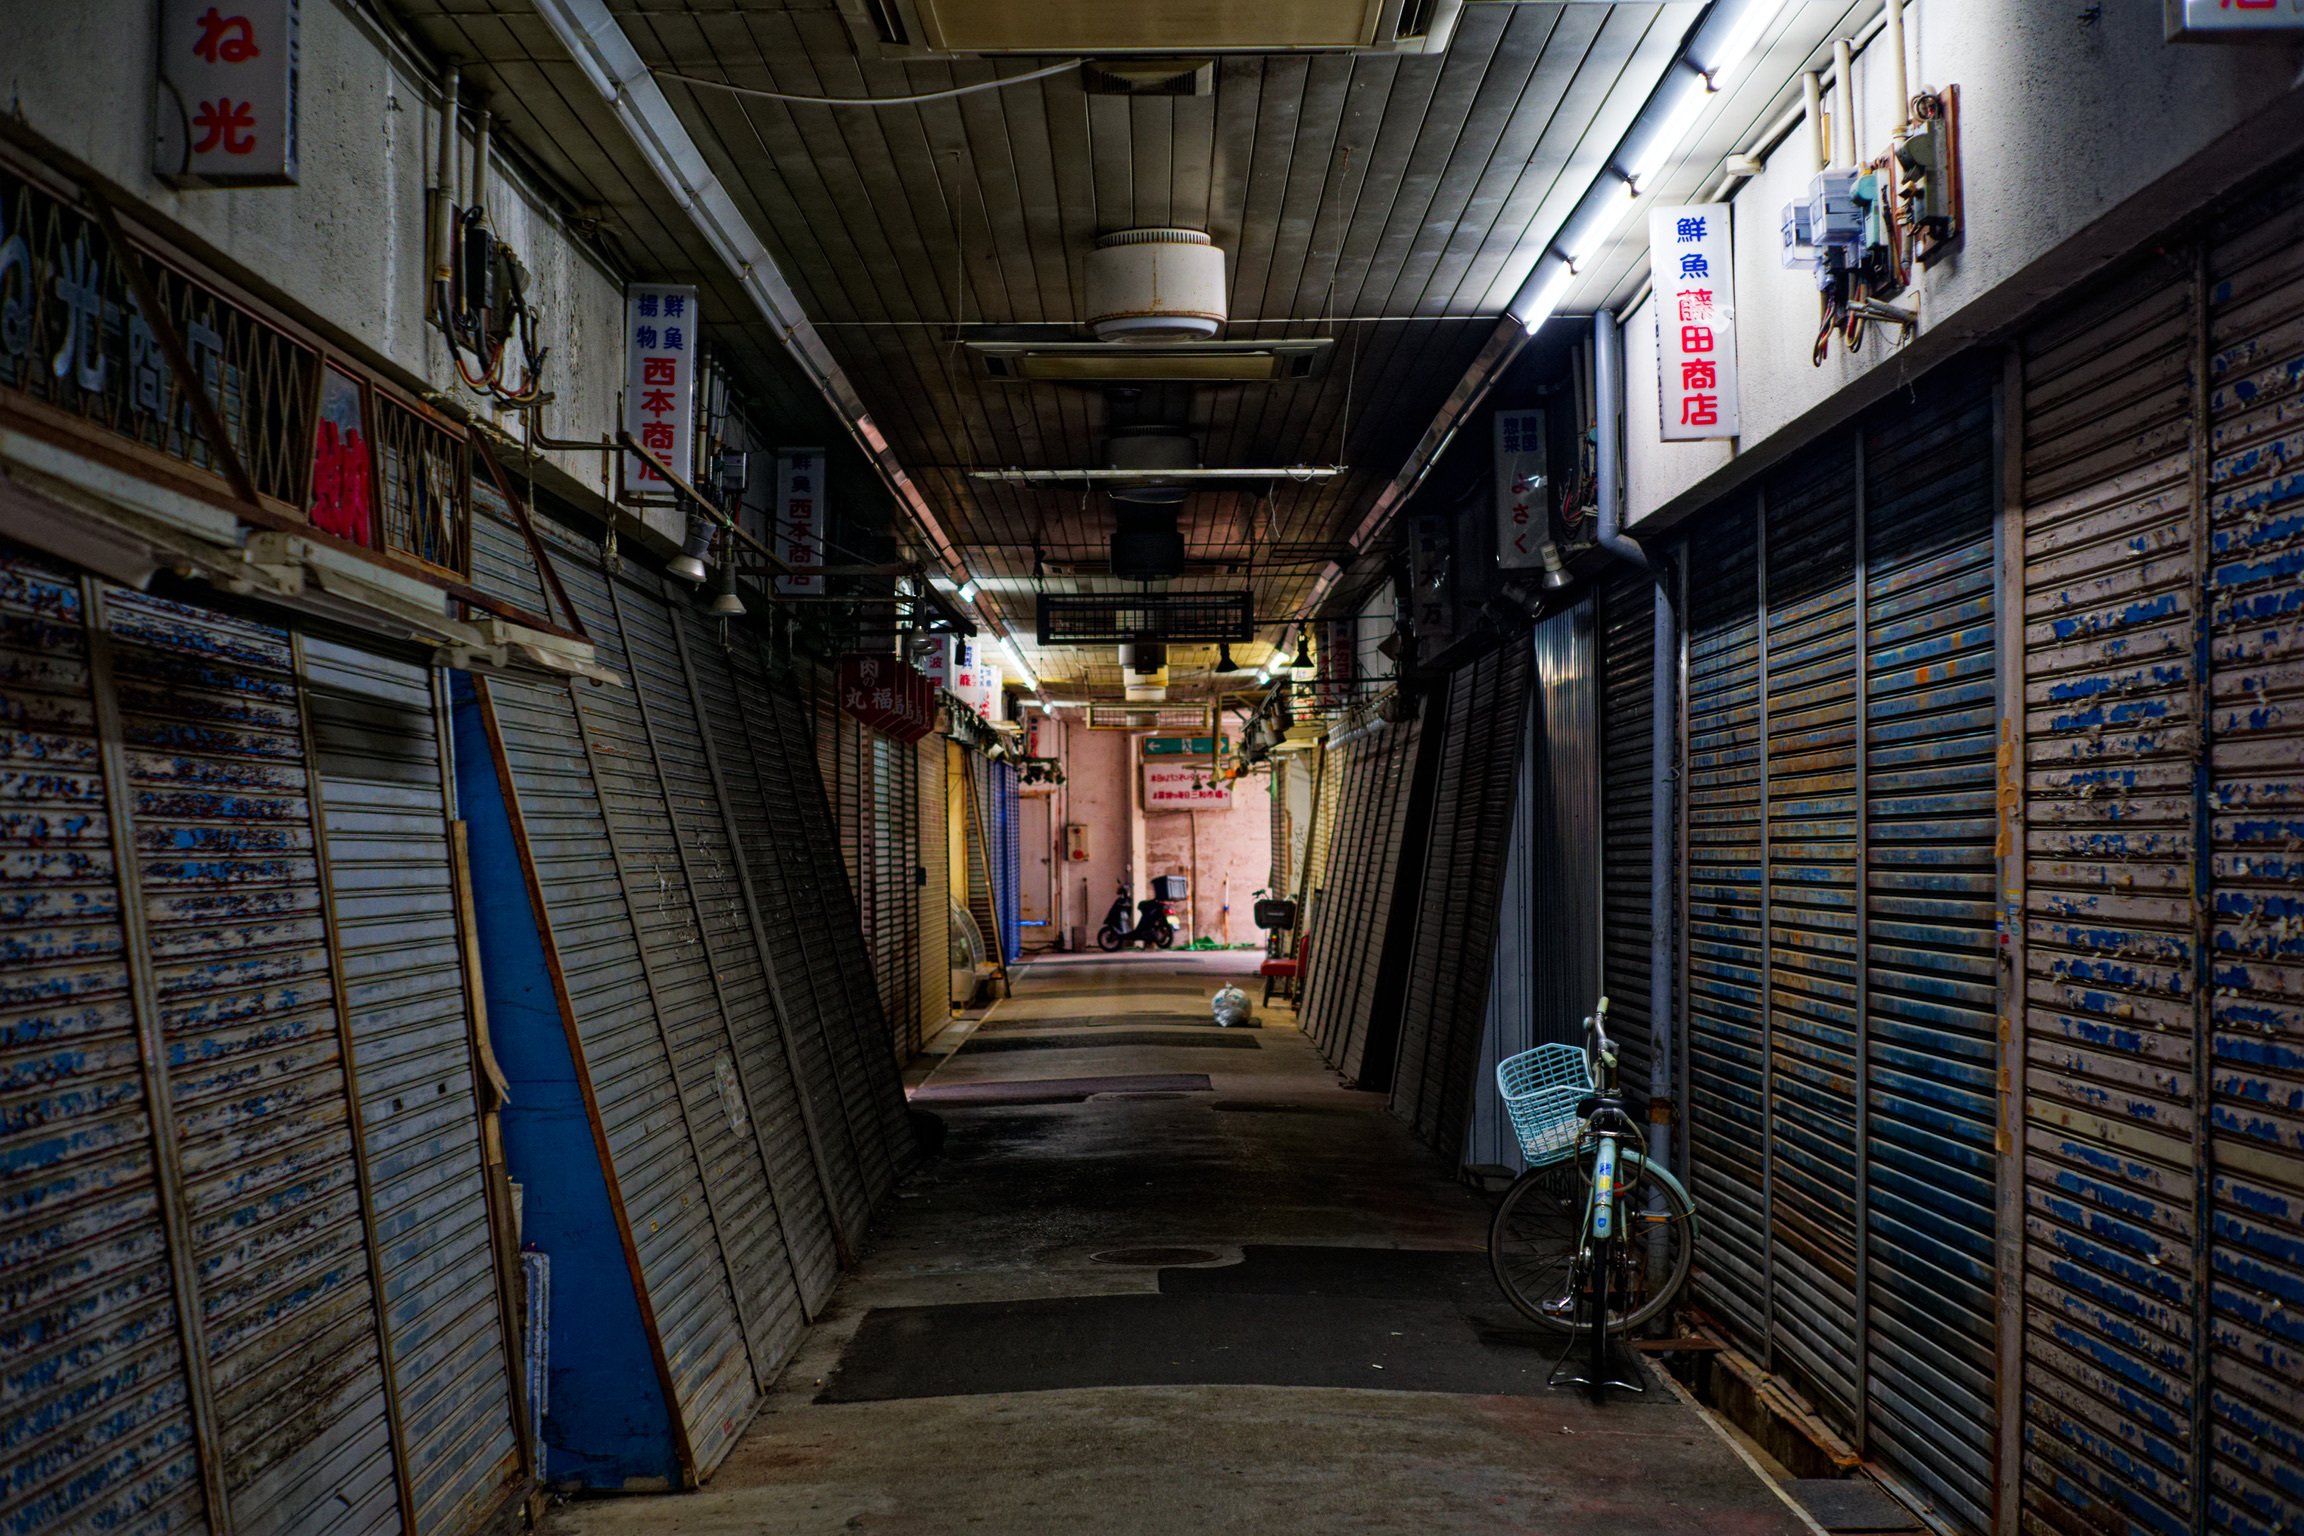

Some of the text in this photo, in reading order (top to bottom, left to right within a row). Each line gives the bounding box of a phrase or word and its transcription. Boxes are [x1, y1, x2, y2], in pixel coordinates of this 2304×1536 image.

[193, 6, 262, 155] ね光
[1511, 473, 1529, 554] よさく
[844, 686, 894, 711] 丸福
